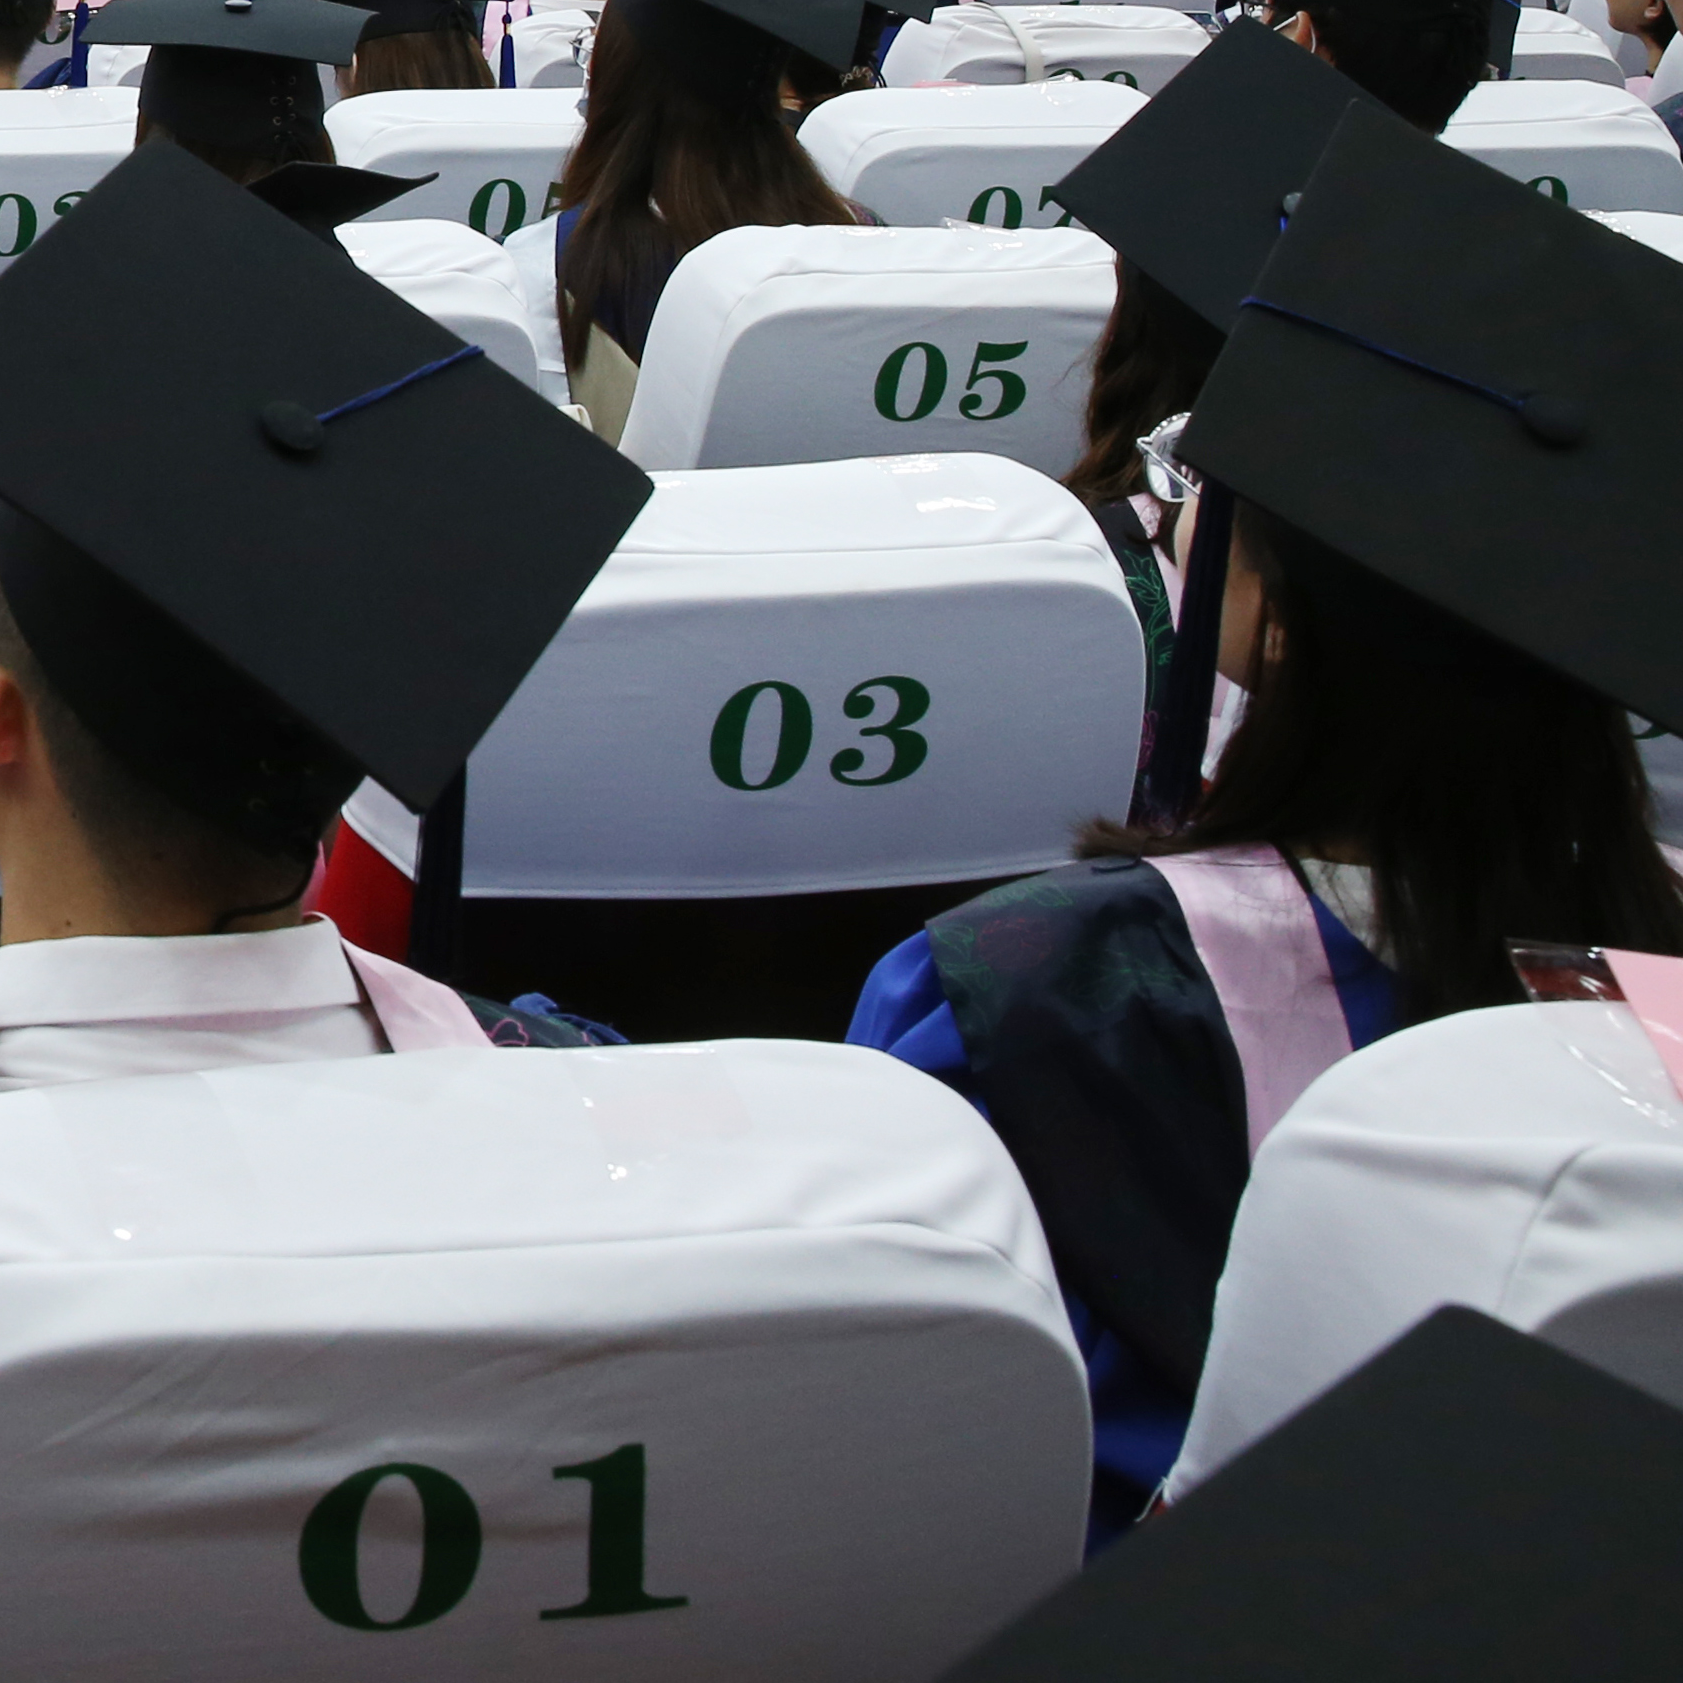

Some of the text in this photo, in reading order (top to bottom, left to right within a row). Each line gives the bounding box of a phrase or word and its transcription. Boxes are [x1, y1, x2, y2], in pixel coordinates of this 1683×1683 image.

[873, 341, 1030, 423] 05
[709, 674, 932, 792] 03
[297, 1442, 690, 1633] 01
